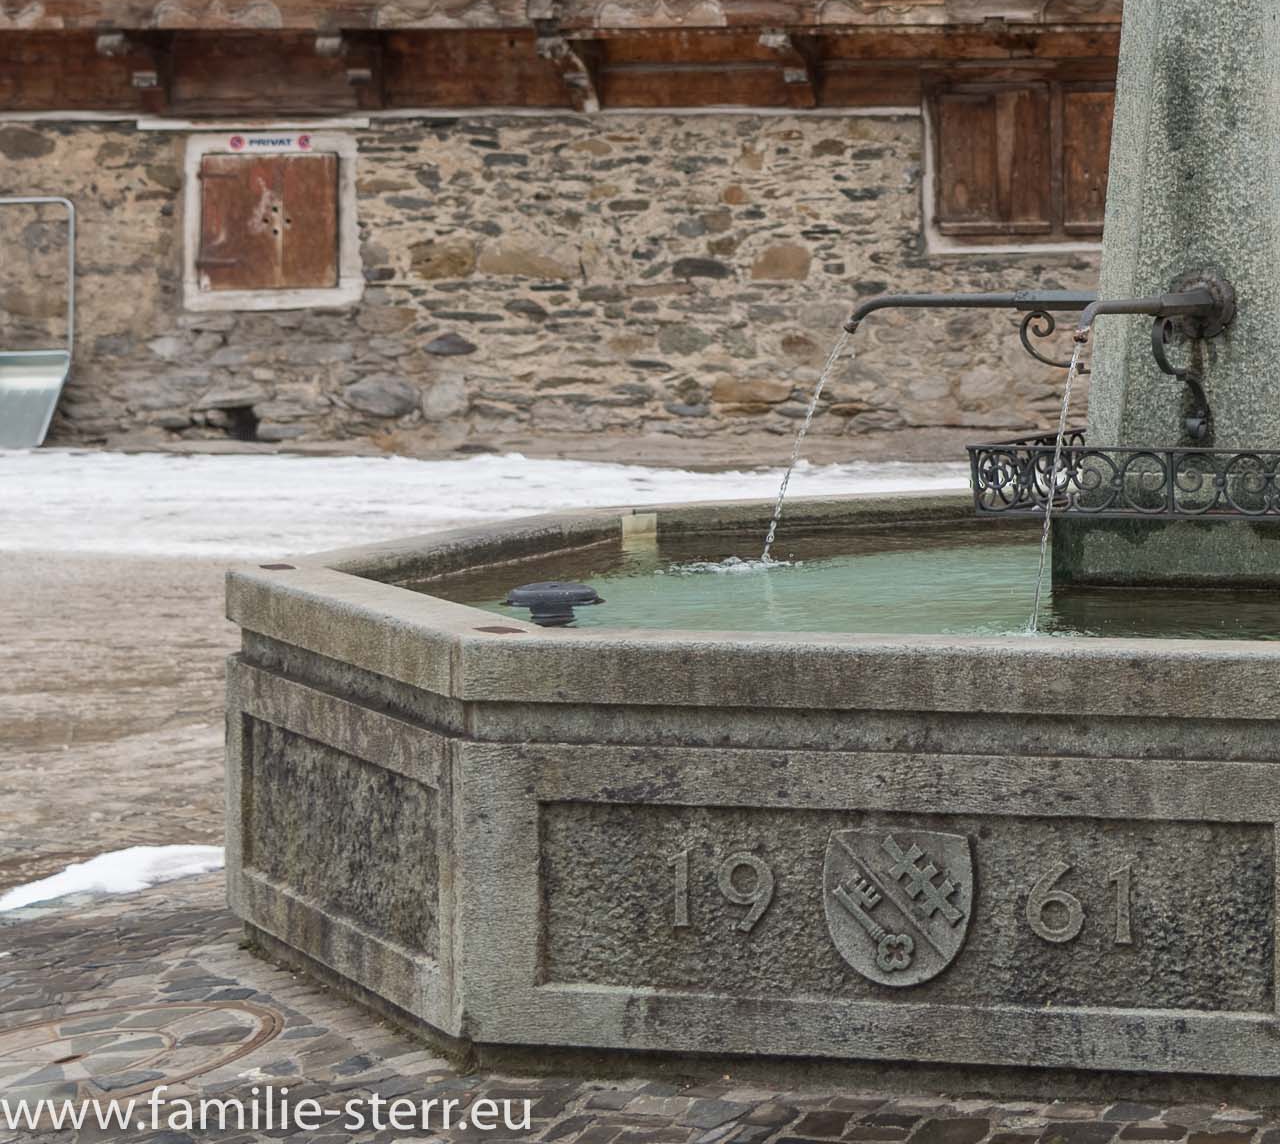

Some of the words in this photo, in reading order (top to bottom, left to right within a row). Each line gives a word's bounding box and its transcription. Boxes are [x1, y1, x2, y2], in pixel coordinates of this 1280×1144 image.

[249, 138, 292, 146] PRIVAT
[666, 850, 777, 933] 19
[1025, 861, 1134, 944] 61
